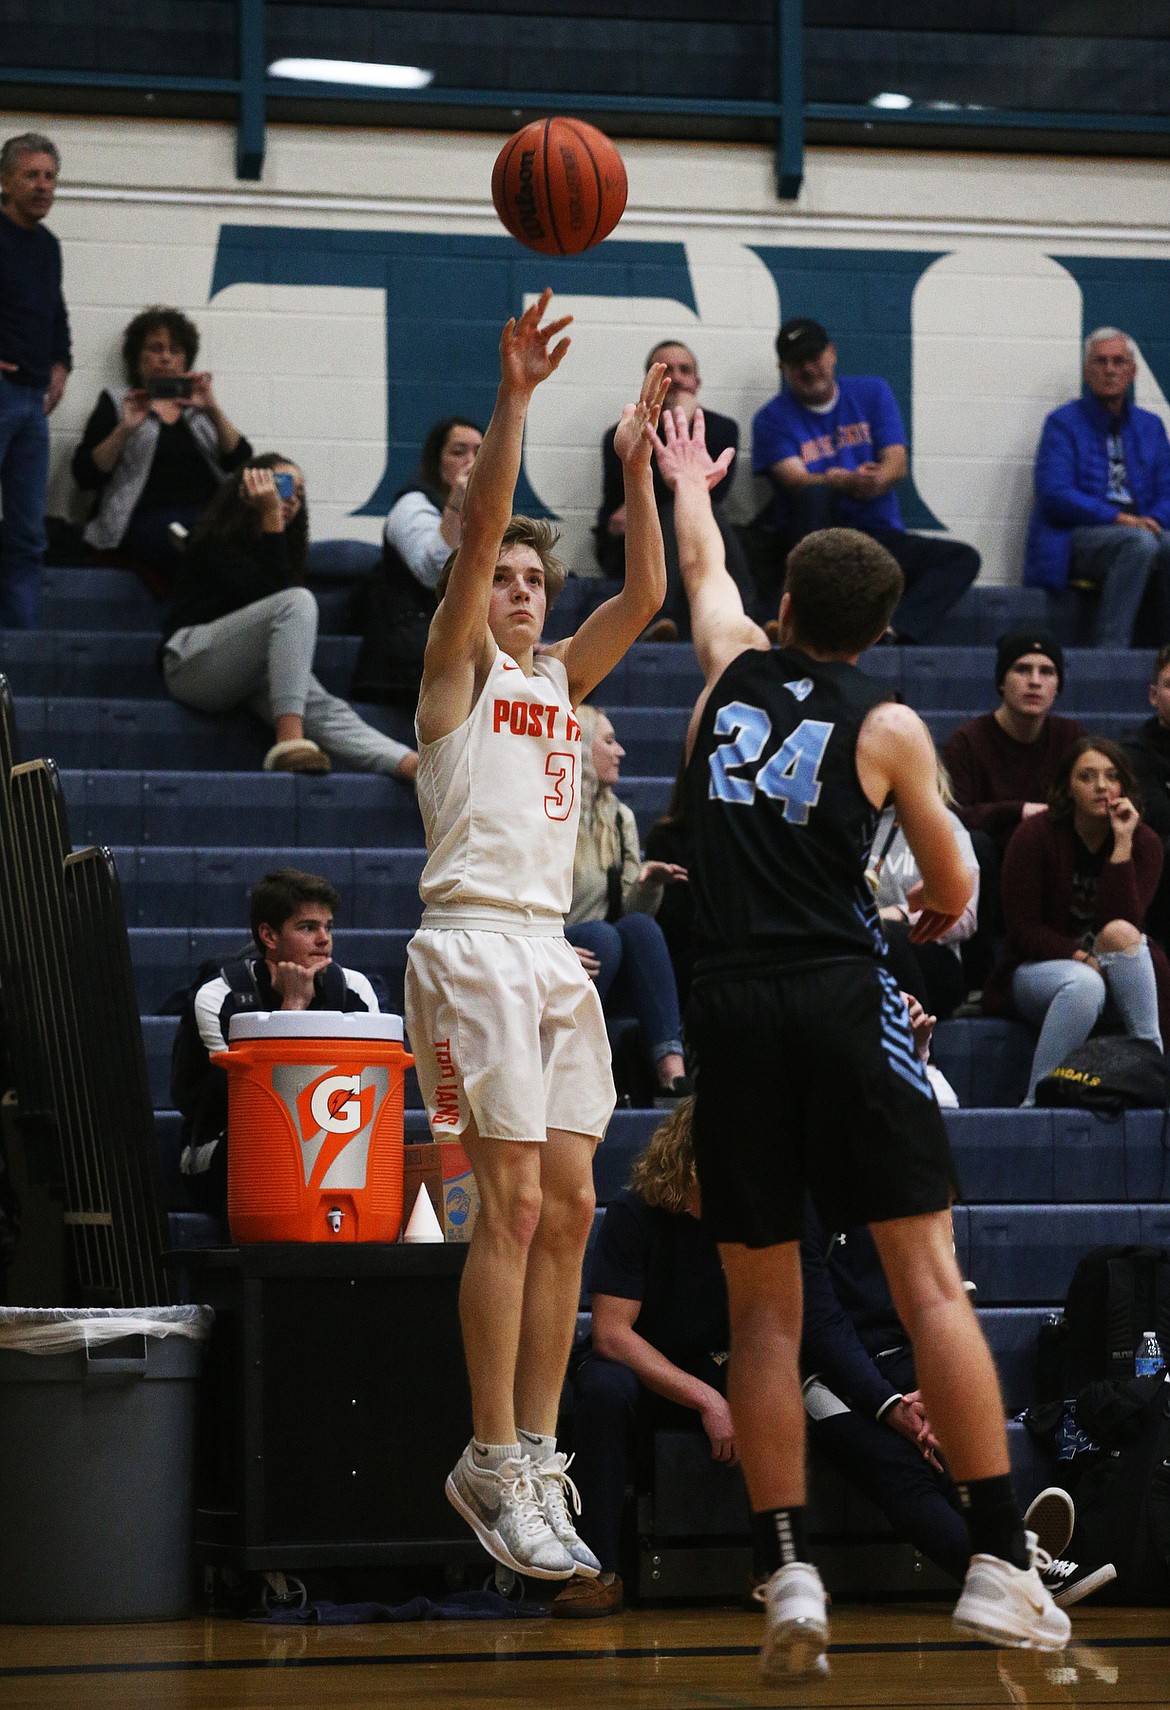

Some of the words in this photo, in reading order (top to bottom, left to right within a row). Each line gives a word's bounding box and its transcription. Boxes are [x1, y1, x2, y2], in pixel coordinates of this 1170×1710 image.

[493, 699, 560, 739] POST
[543, 751, 576, 822] 3
[708, 700, 835, 826] 24
[311, 1075, 361, 1134] G
